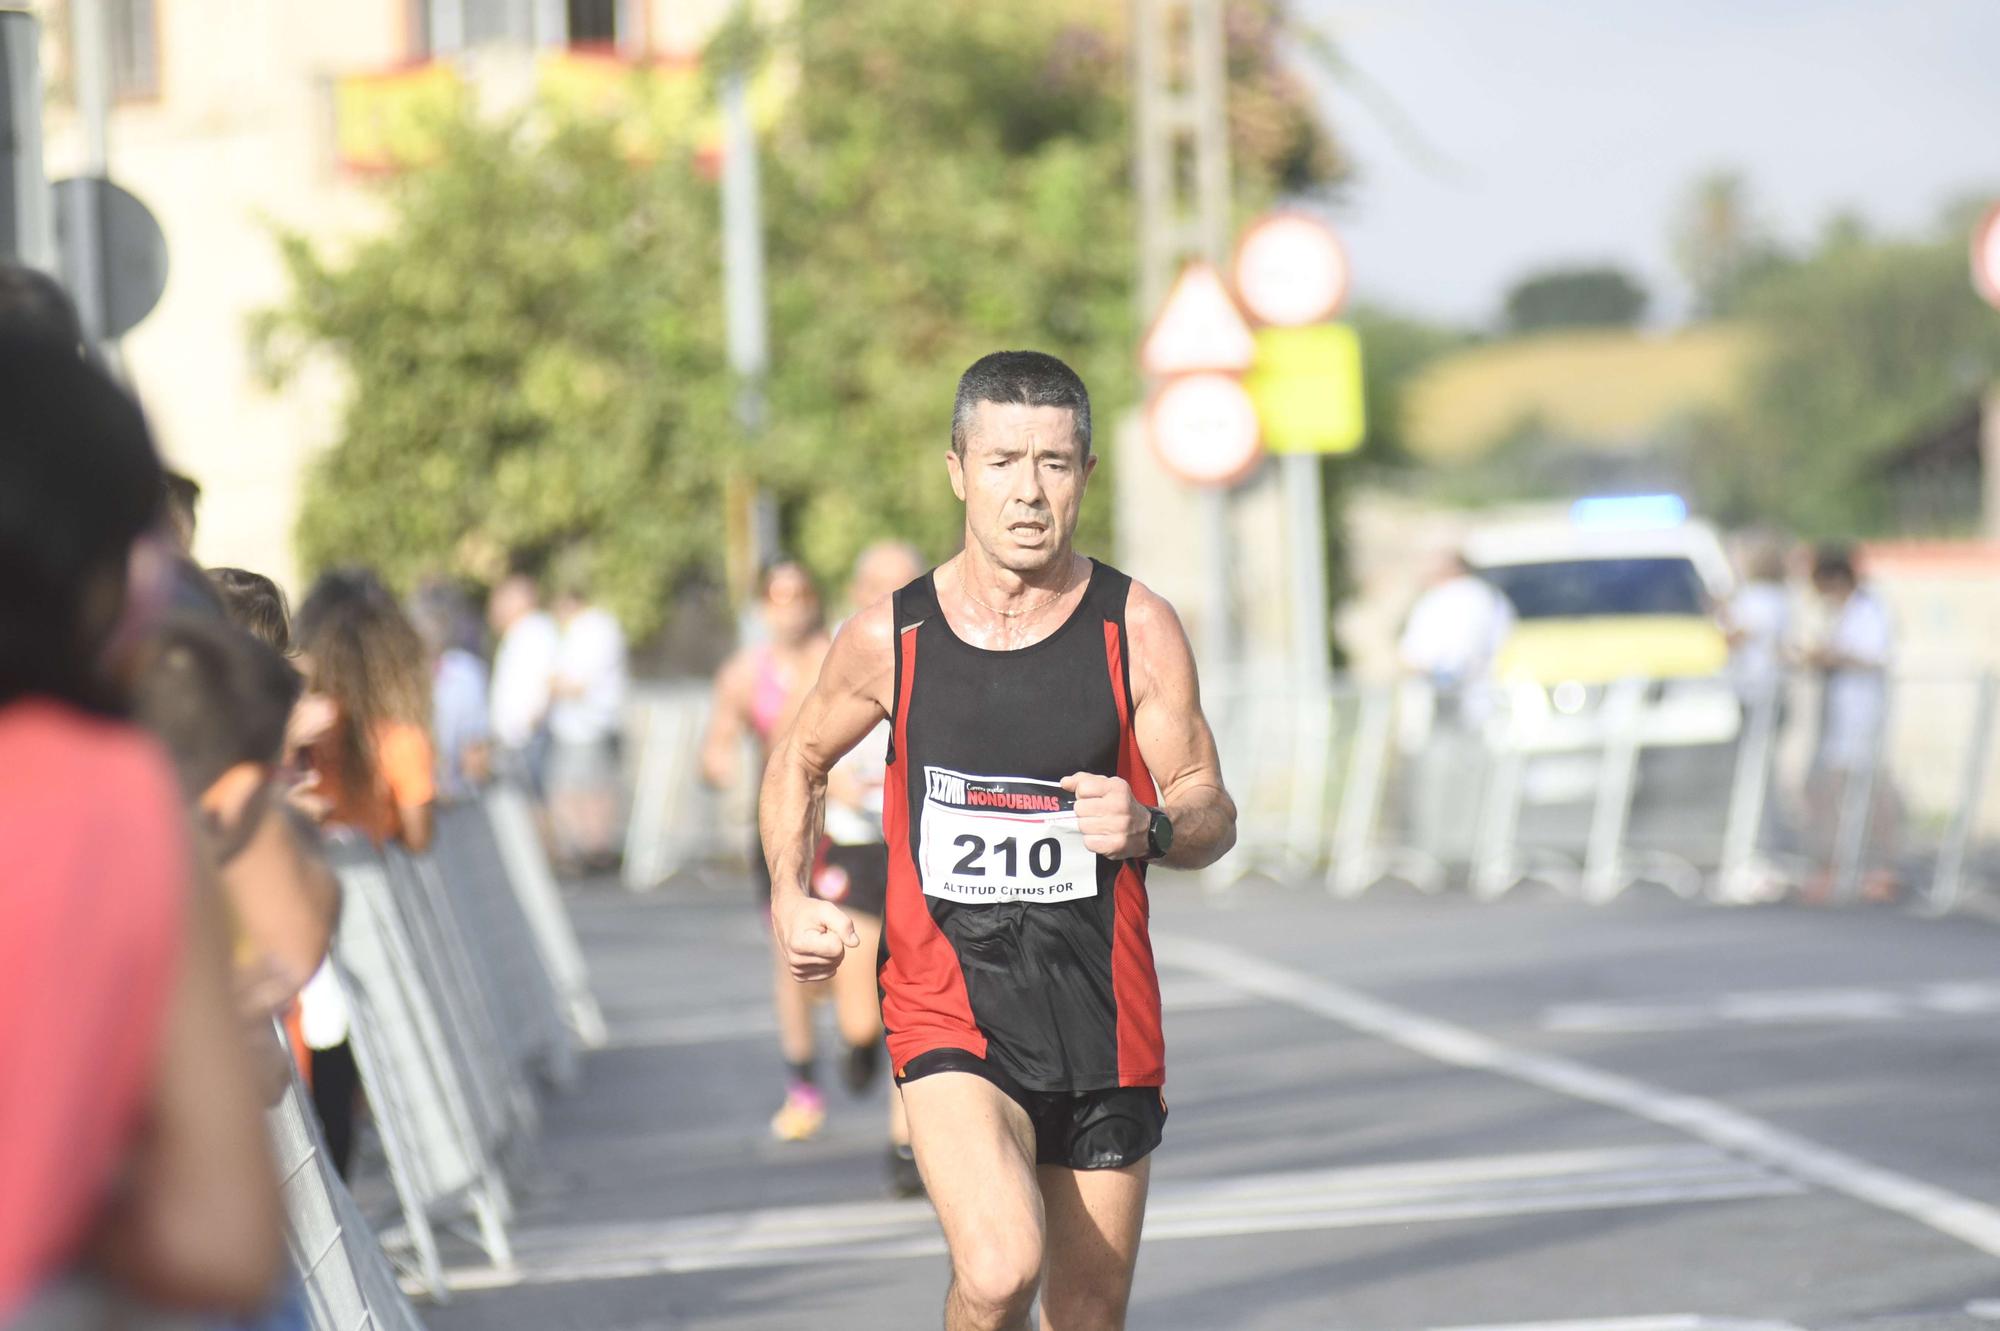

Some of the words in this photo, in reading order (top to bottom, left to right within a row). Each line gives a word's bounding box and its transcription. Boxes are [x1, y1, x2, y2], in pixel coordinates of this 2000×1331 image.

[967, 790, 1060, 811] NONDUERMAS
[952, 834, 1062, 878] 210
[943, 881, 996, 895] ALTITUD
[1000, 886, 1045, 896] CITIUS
[1049, 882, 1074, 895] FOR
